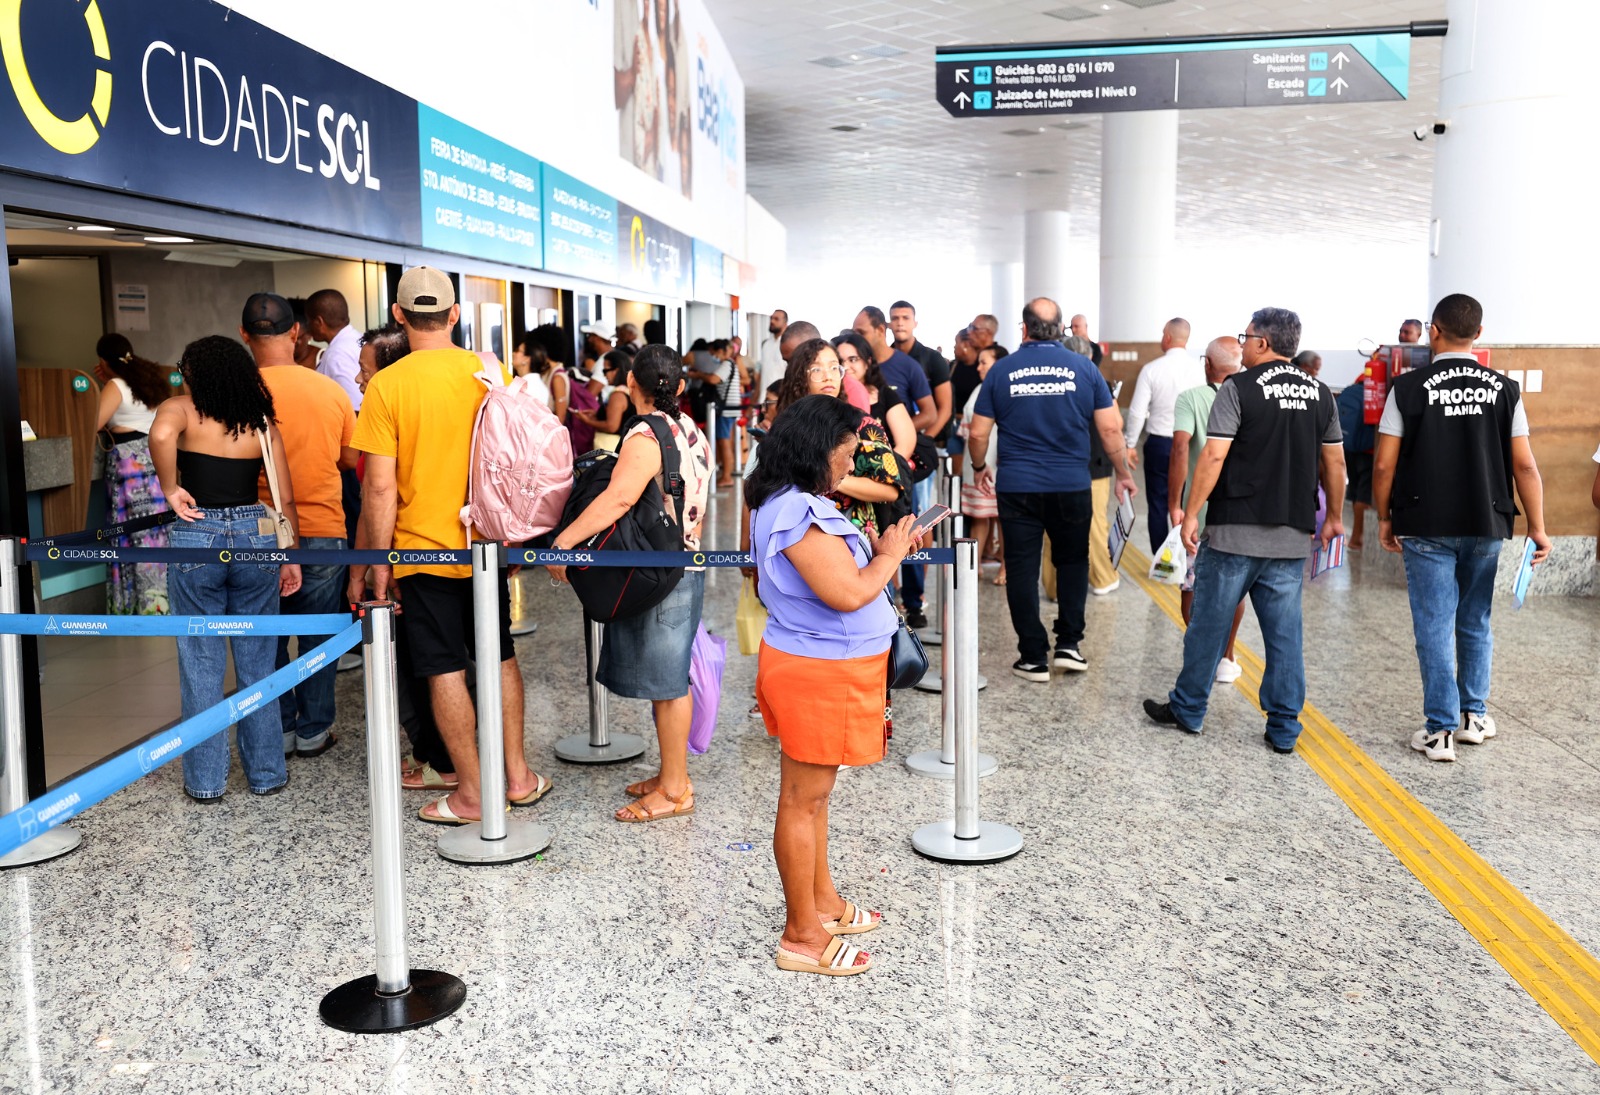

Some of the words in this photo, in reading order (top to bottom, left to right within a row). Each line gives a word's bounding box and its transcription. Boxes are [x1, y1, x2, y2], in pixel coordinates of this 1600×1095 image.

[995, 63, 1036, 76] Guichês
[1037, 63, 1056, 74] G03
[1058, 65, 1065, 74] a
[1066, 62, 1087, 74] G16
[1094, 62, 1115, 73] G70
[1267, 77, 1305, 89] Escada
[995, 90, 1034, 101] Juizado
[1035, 89, 1048, 99] de
[1049, 87, 1093, 99] Menores
[1023, 100, 1043, 109] Court
[1049, 99, 1067, 108] Level
[1008, 366, 1076, 382] FISCALIZAÇÃO
[1422, 366, 1503, 391] FISCALIZAÇÃO
[75, 380, 87, 388] 04
[1009, 382, 1066, 395] PROCON
[1262, 383, 1320, 401] PROCON
[1428, 387, 1498, 405] PROCON
[1444, 404, 1483, 417] BAHIA
[63, 549, 99, 559] CIDADE
[100, 549, 119, 559] SOL
[234, 552, 269, 561] CIDADE
[270, 552, 290, 561] SOL
[403, 553, 438, 562] CIDADE
[438, 553, 458, 562] SOL
[539, 552, 574, 562] CIDADE
[575, 553, 594, 562] SOL
[708, 554, 743, 563] CIDADE
[61, 621, 108, 630] GUANABARA
[207, 621, 254, 630] GUANABARA
[150, 736, 182, 761] GUANABARA
